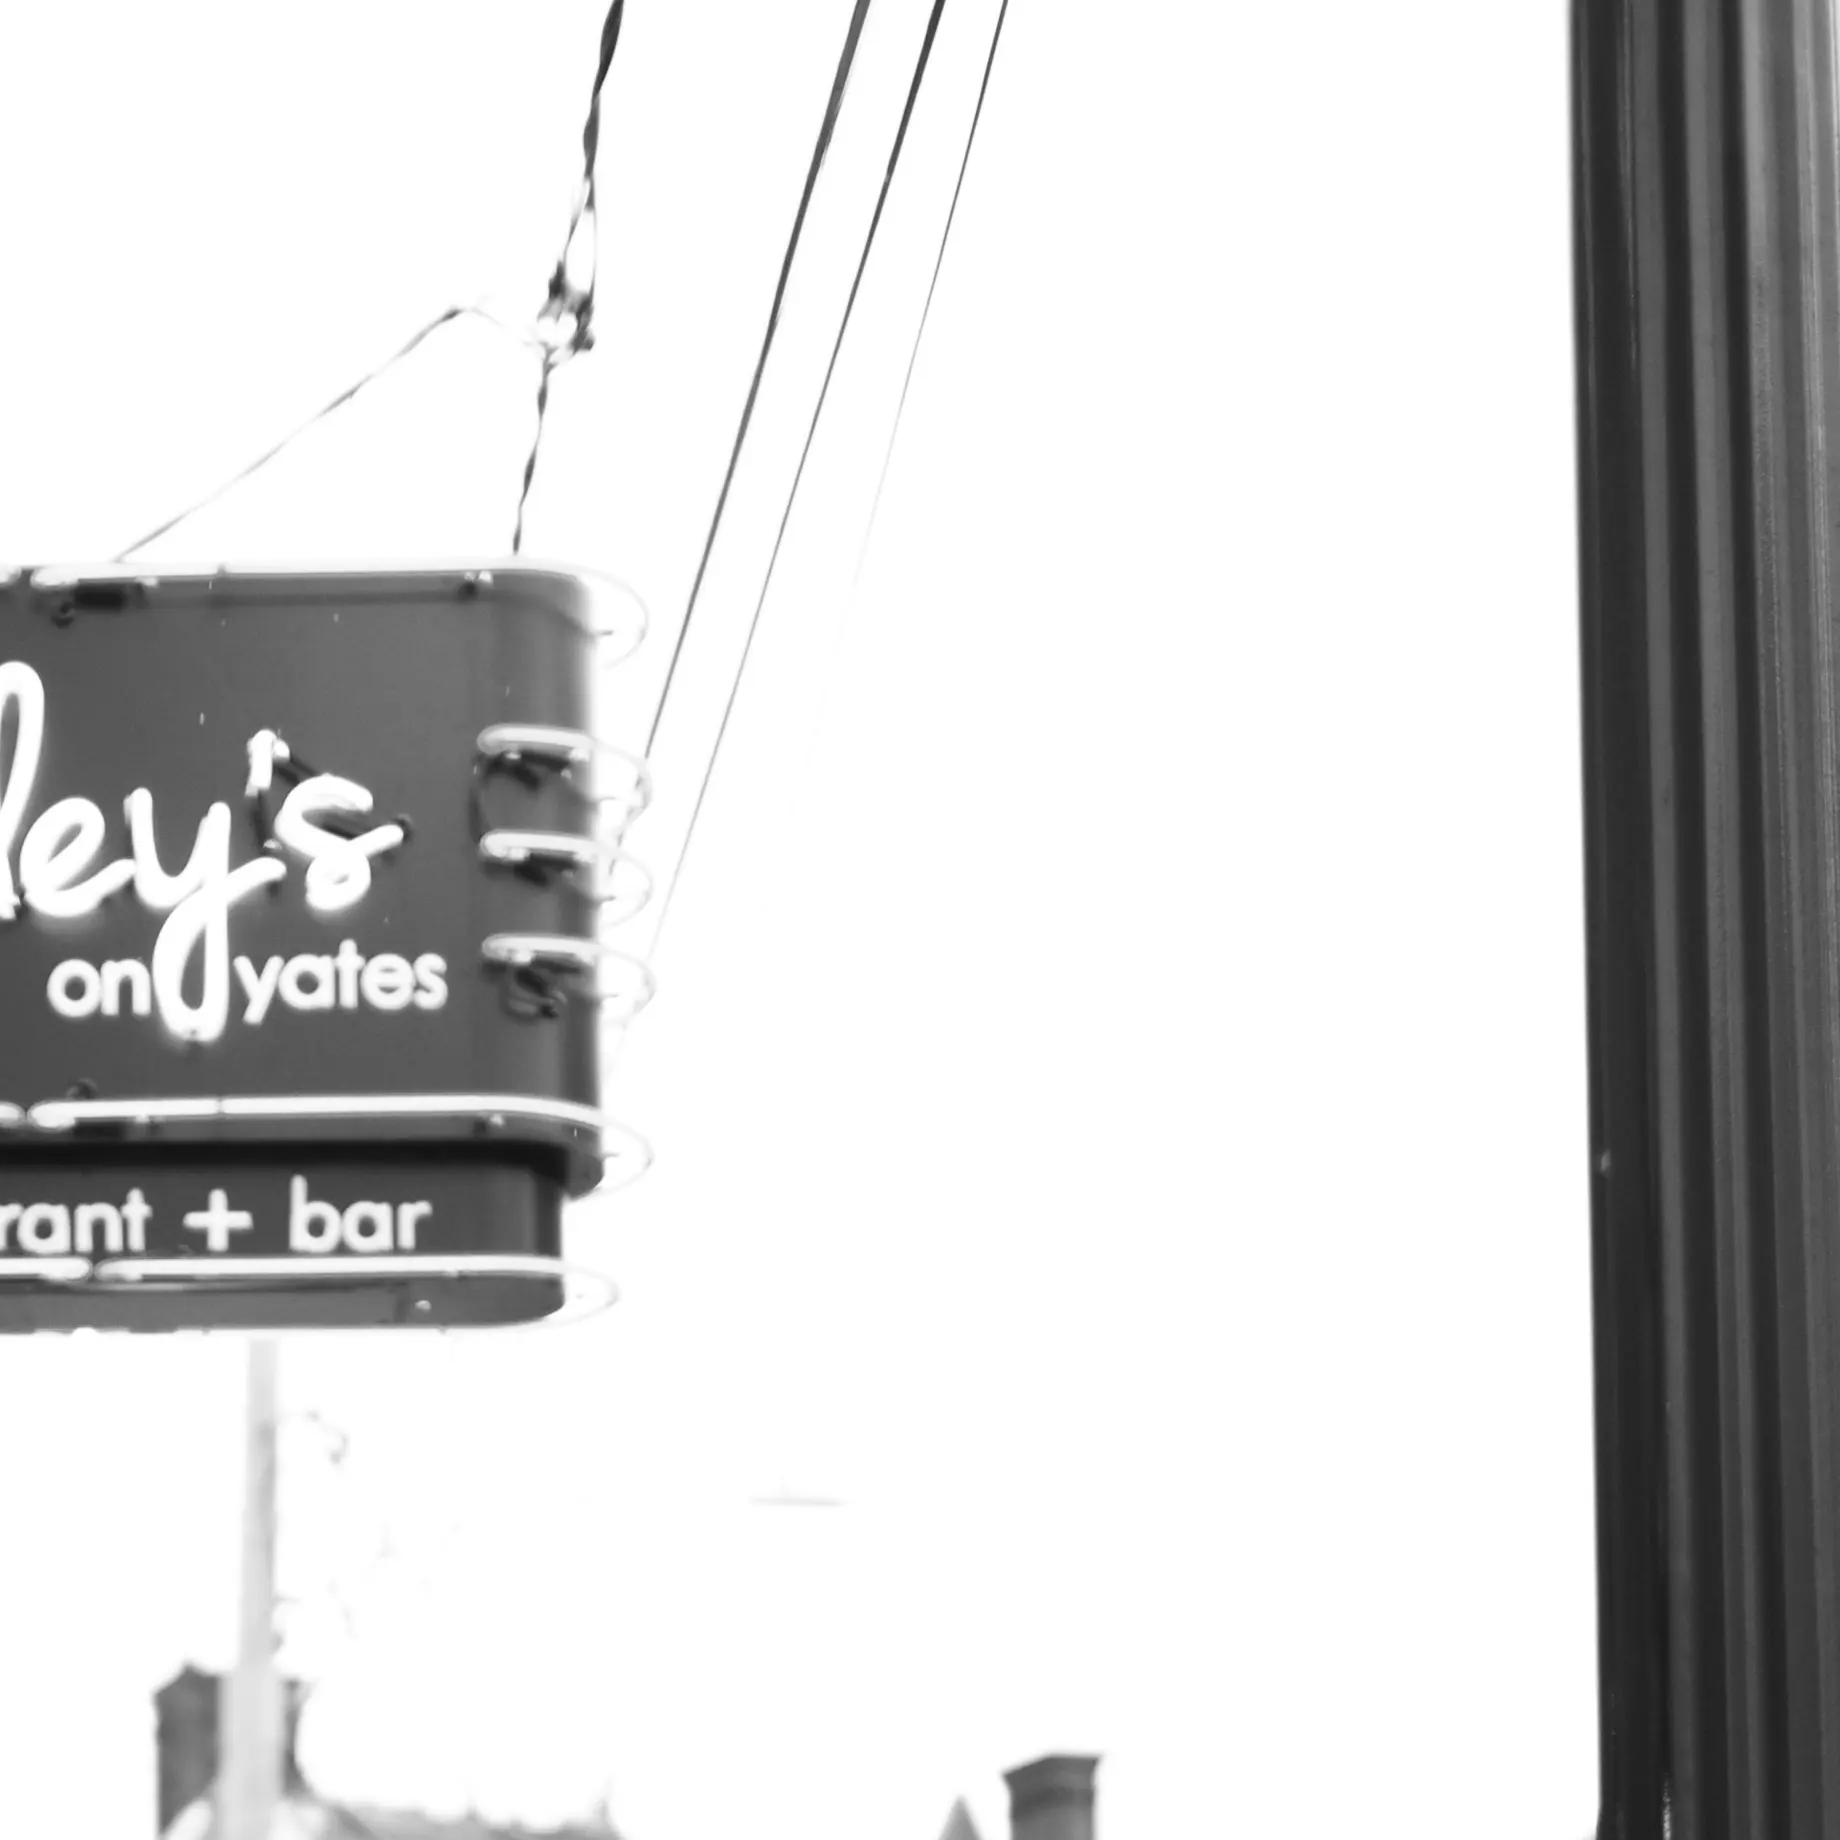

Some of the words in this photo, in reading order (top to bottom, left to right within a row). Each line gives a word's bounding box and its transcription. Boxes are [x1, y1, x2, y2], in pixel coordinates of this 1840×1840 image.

[47, 955, 151, 1017] on
[234, 938, 449, 1025] yates
[289, 1174, 433, 1255] bar
